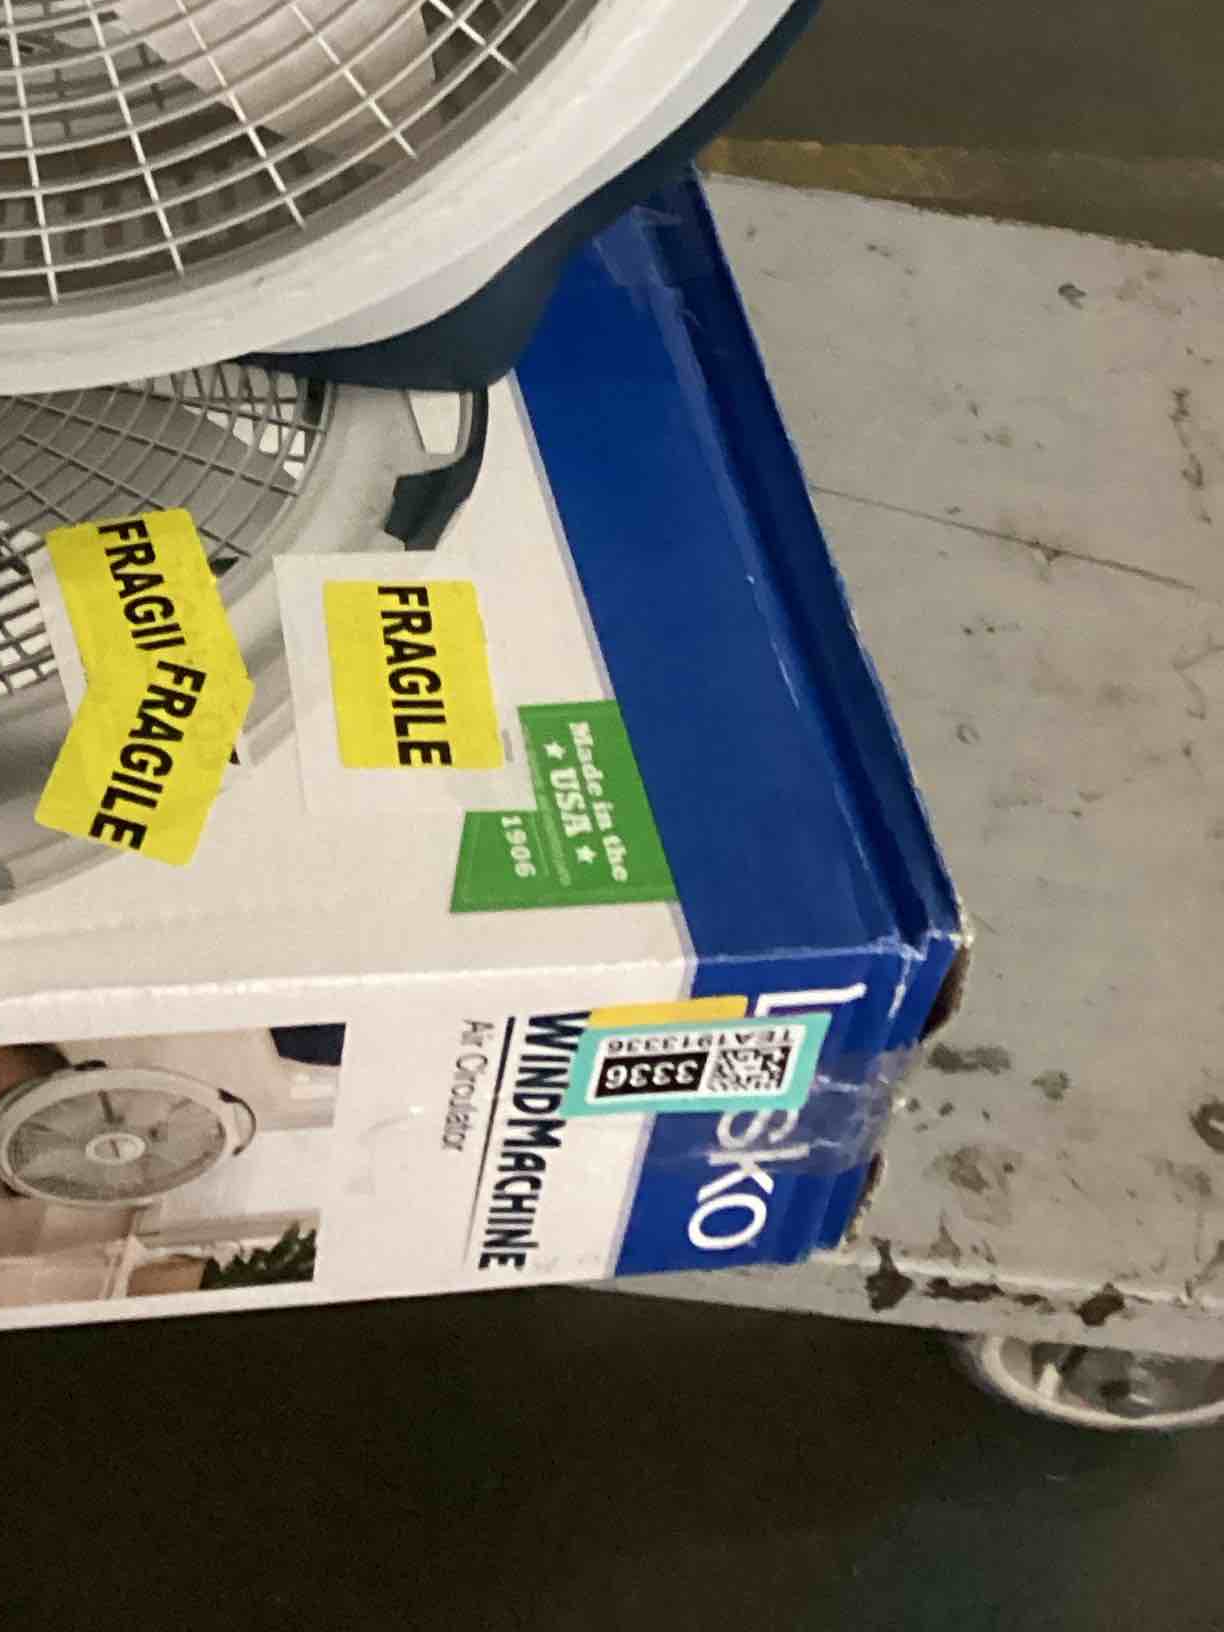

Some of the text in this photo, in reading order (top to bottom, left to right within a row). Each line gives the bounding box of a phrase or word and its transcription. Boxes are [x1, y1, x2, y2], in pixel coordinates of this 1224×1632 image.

[378, 585, 452, 767] FRAGILE
[88, 660, 207, 850] FRAGILE
[549, 767, 593, 838] USA
[568, 721, 628, 882] Made in the
[500, 815, 536, 877] 1906
[441, 1019, 495, 1153] Air Circulator
[605, 1060, 699, 1090] 3336
[688, 983, 867, 1251] Lsko
